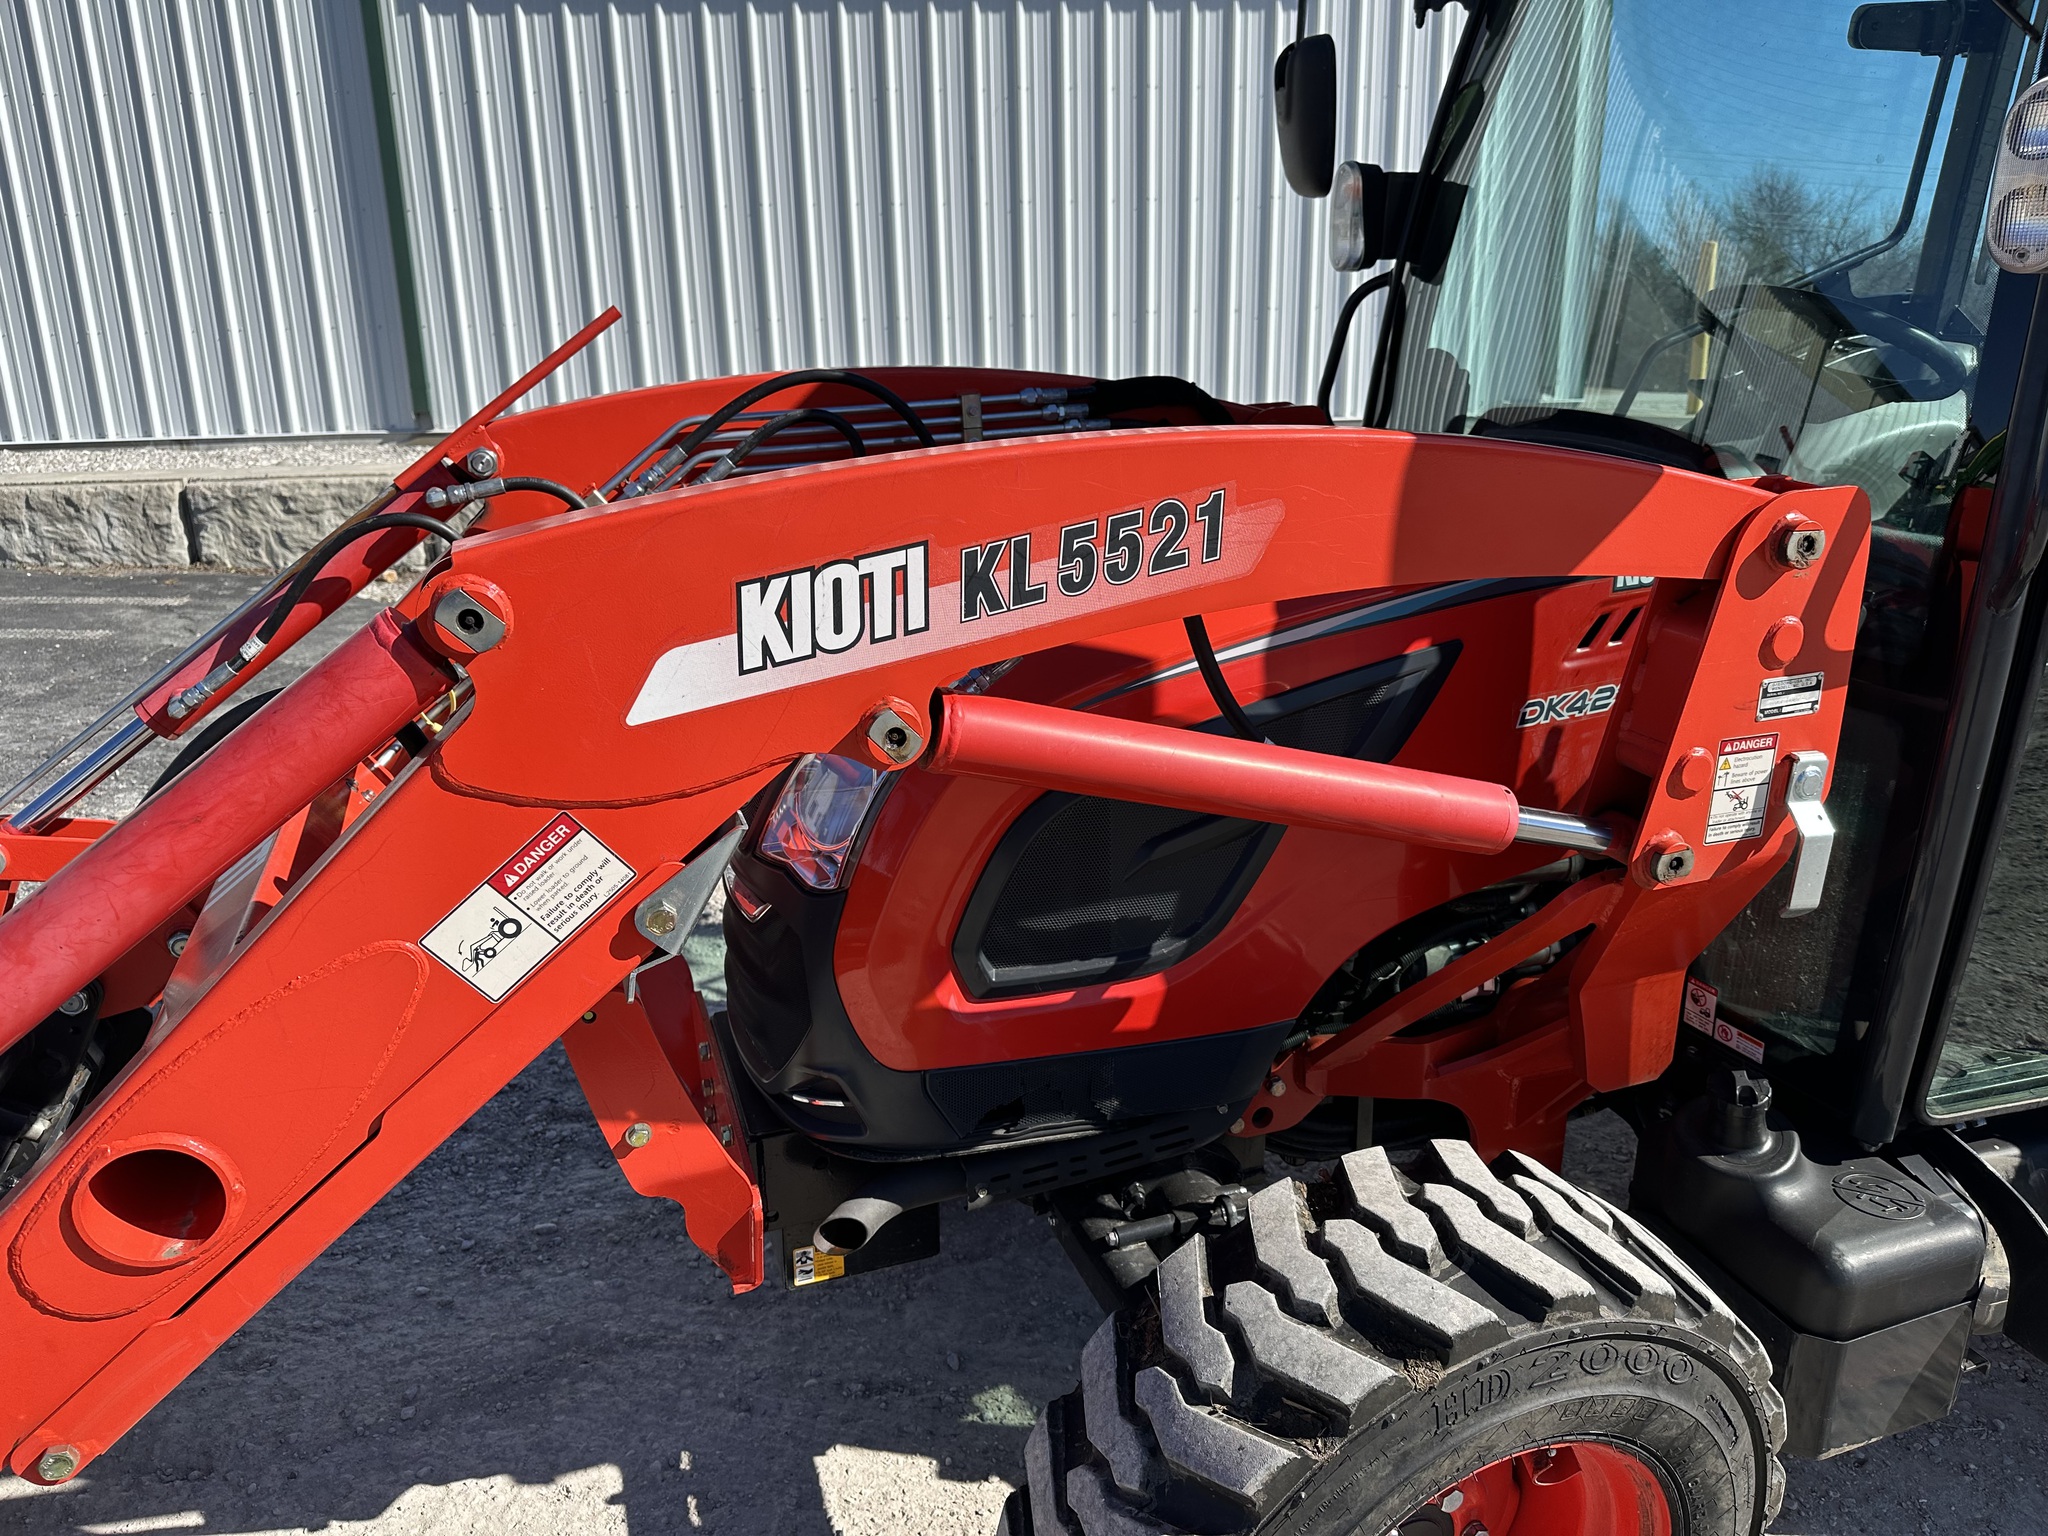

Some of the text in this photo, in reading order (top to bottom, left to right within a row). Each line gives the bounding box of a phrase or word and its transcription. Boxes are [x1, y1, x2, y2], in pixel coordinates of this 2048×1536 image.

[737, 488, 1227, 676] KIOTI KL 5521
[1516, 684, 1621, 728] DK42
[1733, 737, 1773, 751] DANGER
[1734, 754, 1763, 763] Electrocution
[513, 824, 571, 875] DANGER
[516, 838, 583, 898] Do not walk or work under
[523, 886, 539, 901] raised
[530, 893, 546, 908] Lower
[545, 878, 562, 893] loader
[569, 854, 589, 874] ground
[540, 857, 611, 922] Failure to comply will
[547, 876, 604, 928] result in death or
[603, 872, 632, 898] L2505-14081
[536, 898, 550, 911] when
[553, 892, 600, 933] serious injury.
[1529, 1342, 1695, 1390] 2000
